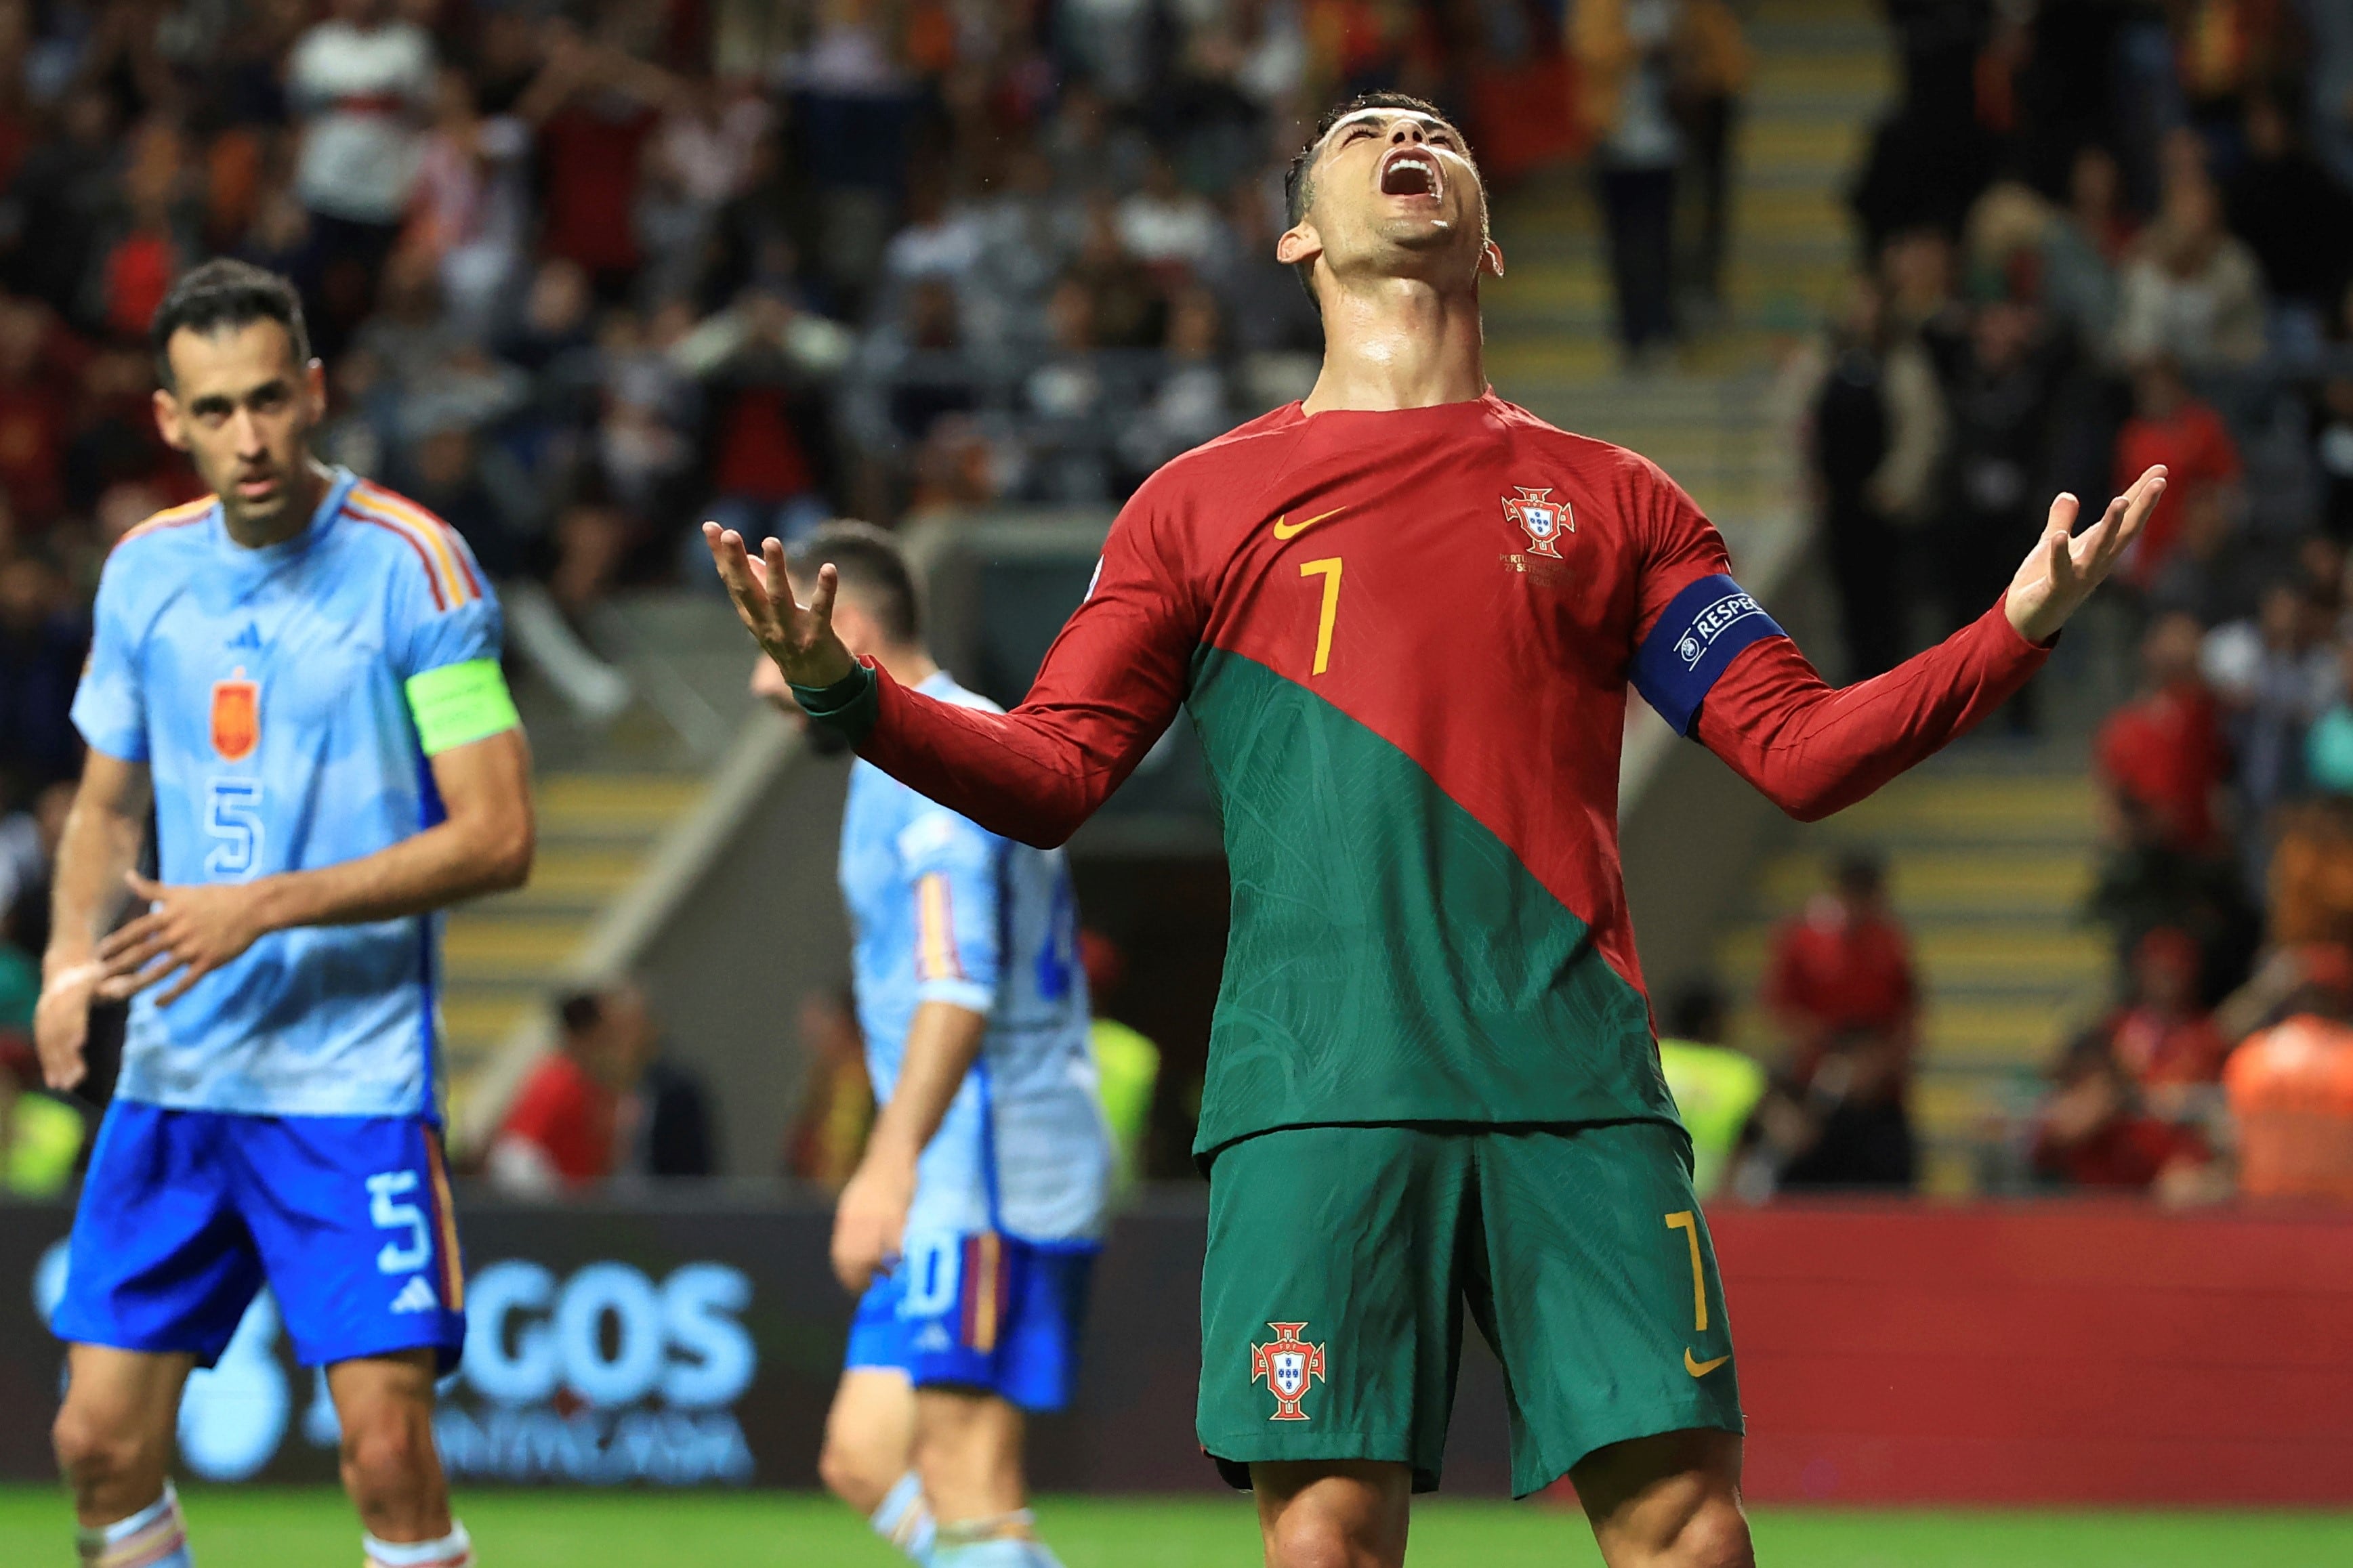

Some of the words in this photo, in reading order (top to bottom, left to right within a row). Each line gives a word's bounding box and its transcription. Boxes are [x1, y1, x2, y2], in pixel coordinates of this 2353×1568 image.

[1300, 557, 1342, 676] 7
[204, 776, 266, 885] 5
[365, 1169, 432, 1275] 5
[1665, 1210, 1708, 1332] 7
